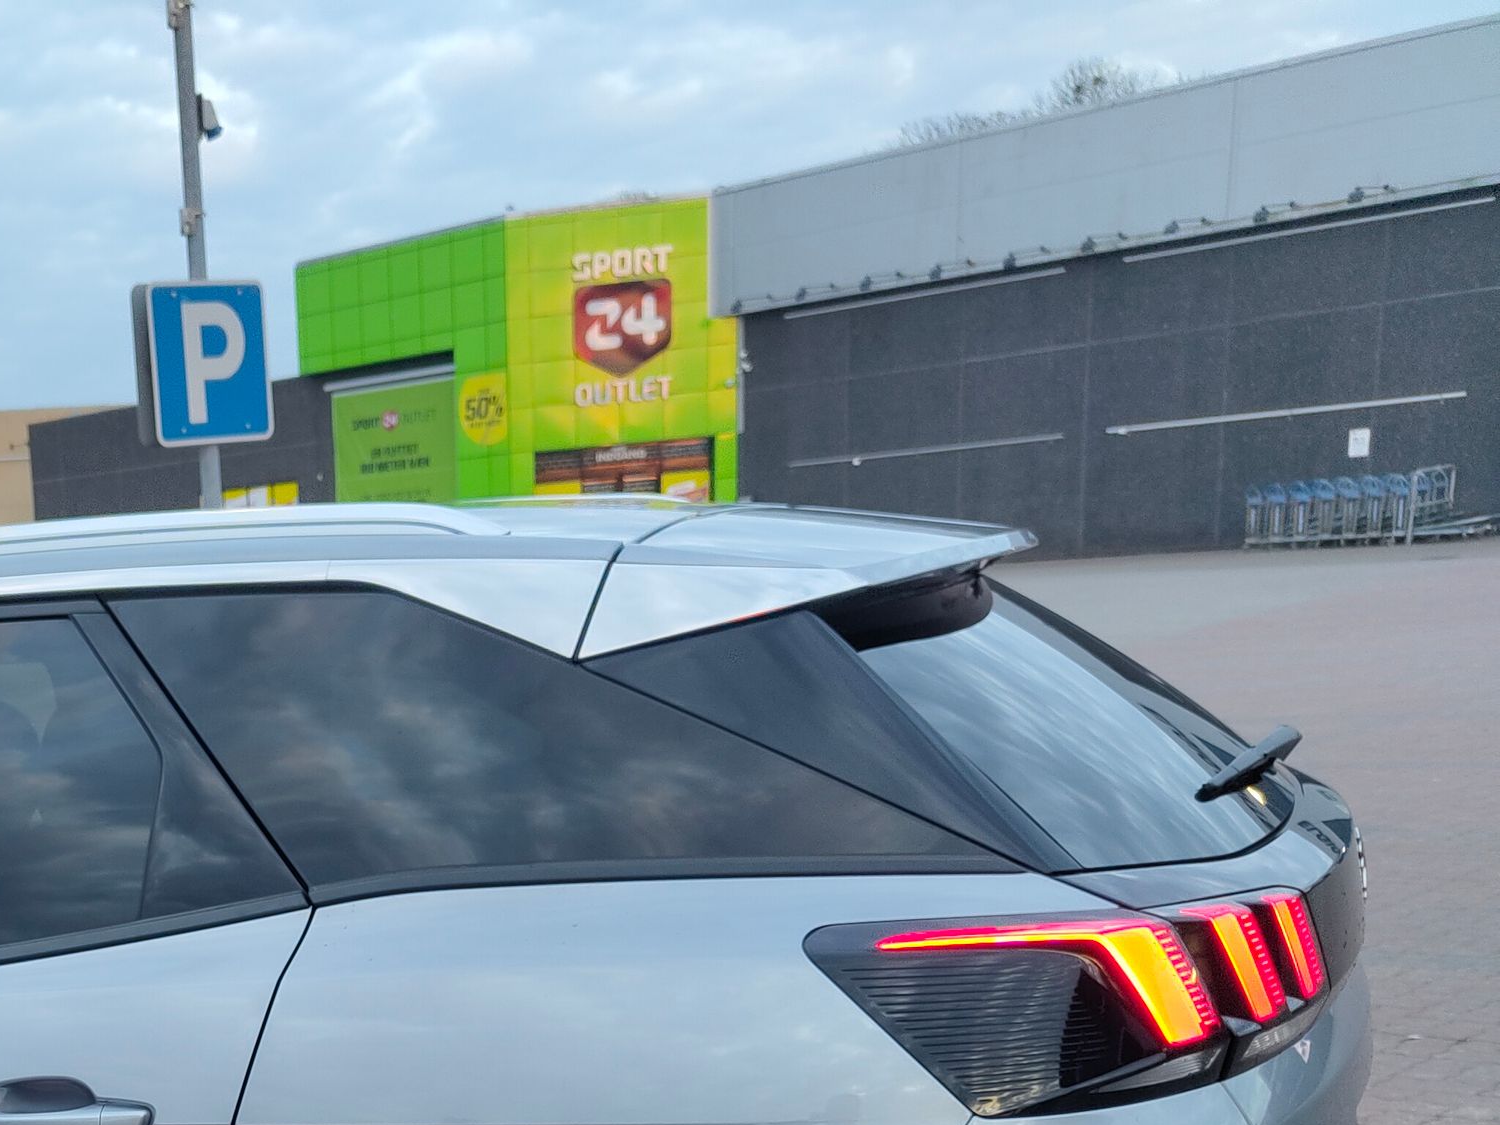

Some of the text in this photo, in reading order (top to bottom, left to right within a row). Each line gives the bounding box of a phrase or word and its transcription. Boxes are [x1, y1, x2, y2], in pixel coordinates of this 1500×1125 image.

[571, 243, 674, 283] SPORT
[584, 292, 667, 351] 24
[180, 300, 246, 425] P
[574, 376, 672, 408] OUTLET
